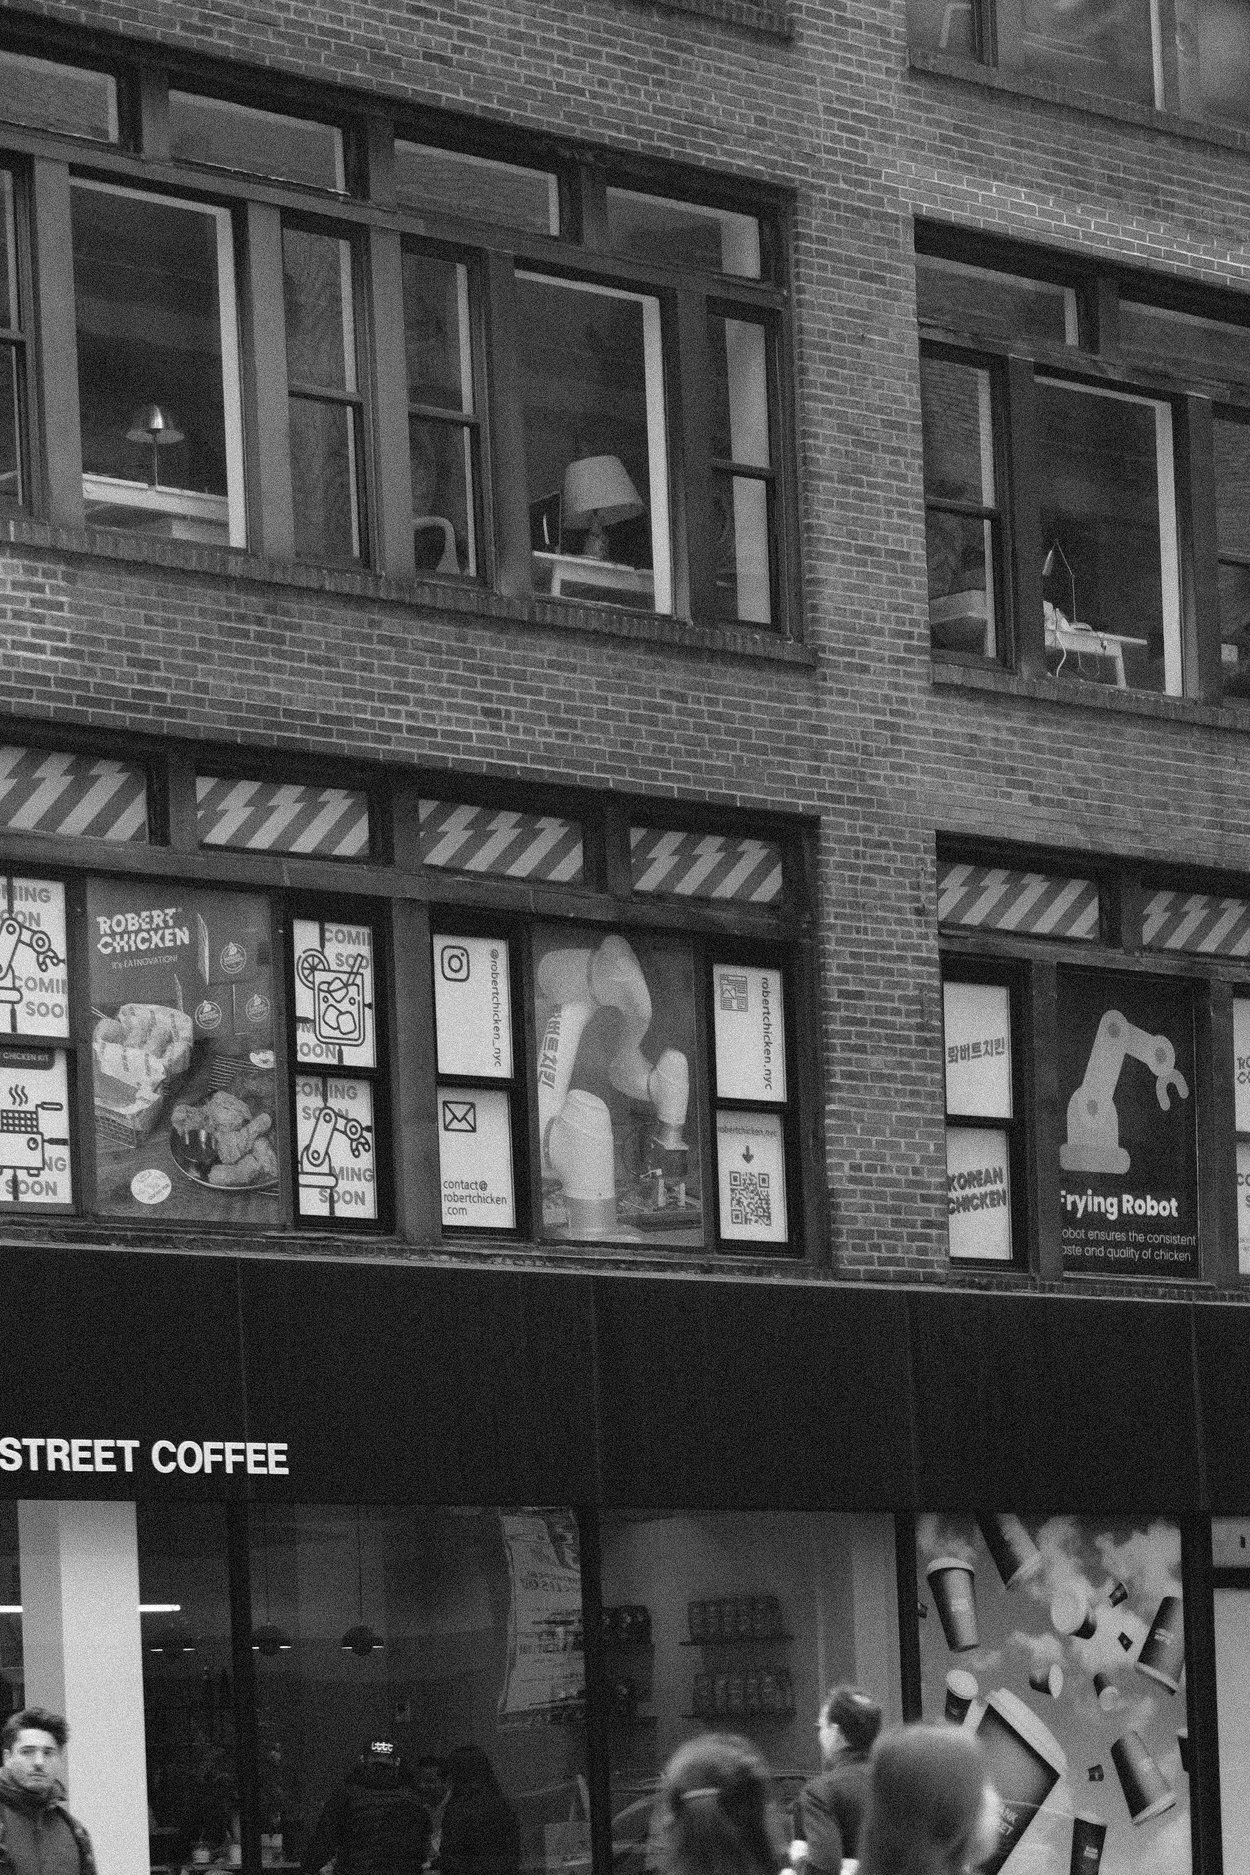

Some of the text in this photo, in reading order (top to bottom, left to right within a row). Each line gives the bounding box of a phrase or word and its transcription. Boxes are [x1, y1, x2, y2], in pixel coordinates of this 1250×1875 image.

[96, 908, 177, 935] ROBERT
[97, 926, 190, 955] CHICKEN
[489, 948, 503, 1067] @robertchicken_nyc
[761, 976, 773, 1091] robertchicken.nyc
[443, 1179, 488, 1191] contact@
[949, 1166, 1004, 1193] KOREAN
[443, 1192, 508, 1205] robertchicken
[446, 1206, 468, 1216] .com
[1061, 1188, 1179, 1220] rying Robot
[1088, 1229, 1127, 1242] ensures
[1129, 1230, 1145, 1243] the
[1147, 1232, 1197, 1246] consistent
[1084, 1245, 1105, 1257] and
[1106, 1246, 1140, 1262] quality
[1142, 1247, 1153, 1260] of
[1153, 1248, 1192, 1262] chicken
[0, 1436, 290, 1475] STREET COFFEE
